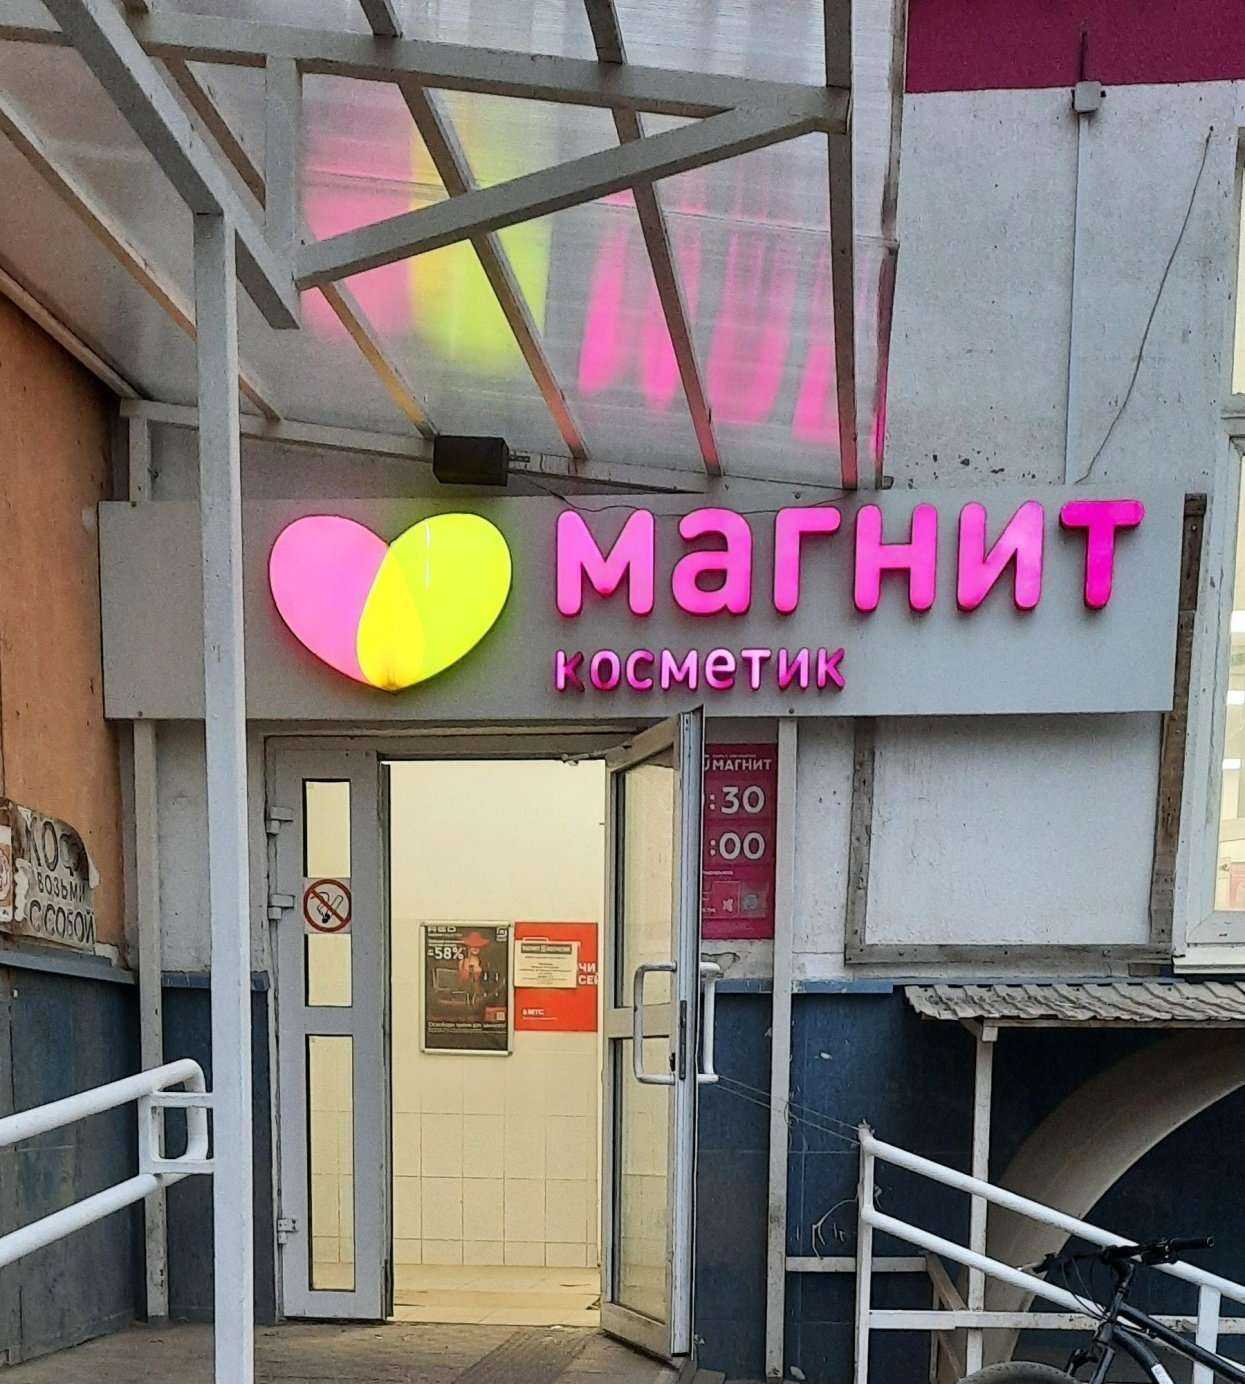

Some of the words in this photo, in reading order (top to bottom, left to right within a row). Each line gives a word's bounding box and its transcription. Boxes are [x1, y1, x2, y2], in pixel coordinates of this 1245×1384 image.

[555, 647, 846, 692] косметик
[712, 759, 772, 771] МАГНИТ
[709, 786, 766, 815] :30
[709, 832, 766, 860] :00
